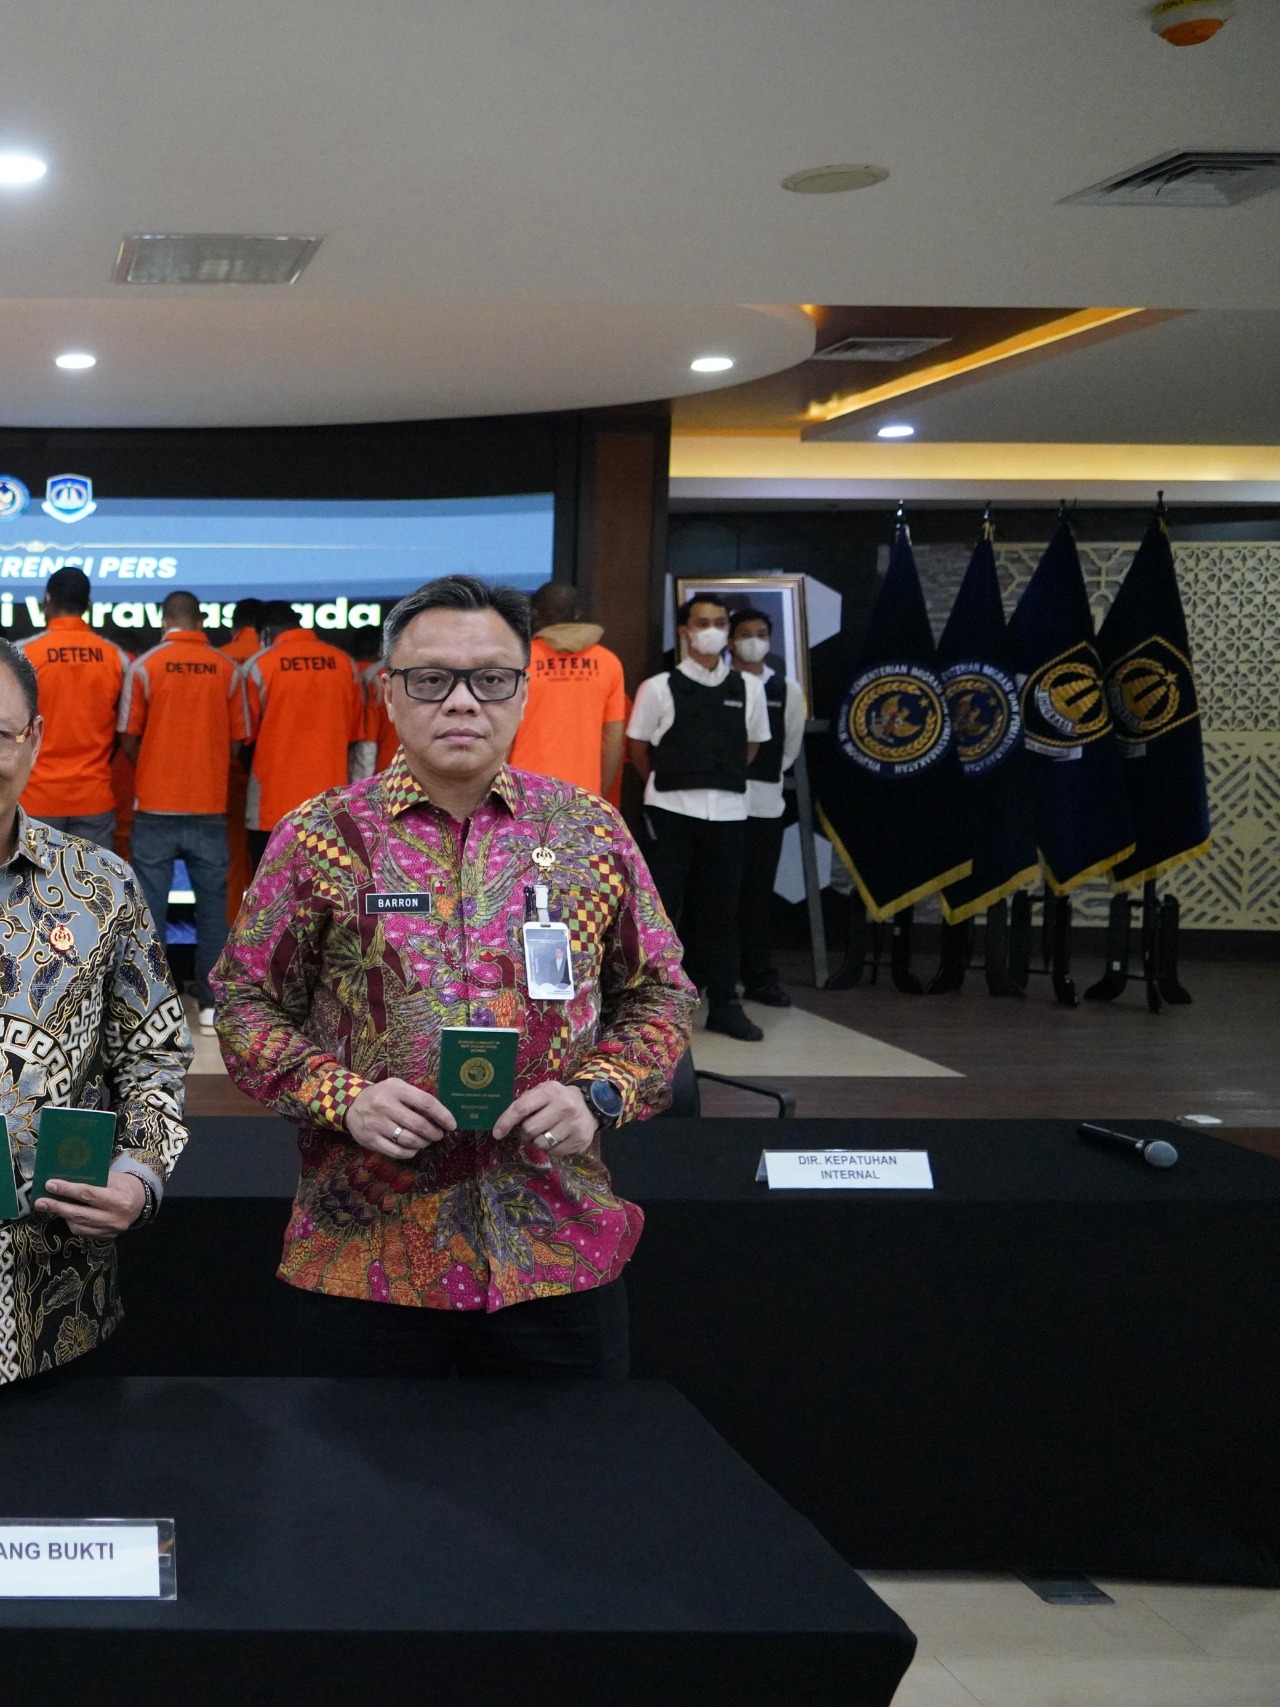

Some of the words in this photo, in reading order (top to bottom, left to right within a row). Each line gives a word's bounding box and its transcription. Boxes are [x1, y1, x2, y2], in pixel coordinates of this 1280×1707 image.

[98, 555, 178, 579] PERS
[25, 596, 381, 630] raasada
[46, 647, 104, 664] DETENI
[165, 662, 217, 675] DETENI
[280, 656, 336, 671] DETENI
[536, 657, 598, 671] DETENI
[378, 898, 419, 908] BARRON
[799, 1155, 822, 1165] DIR.
[825, 1155, 897, 1165] KEPATUHAN
[821, 1170, 880, 1180] INTERNAL
[48, 1541, 114, 1560] BUKTI
